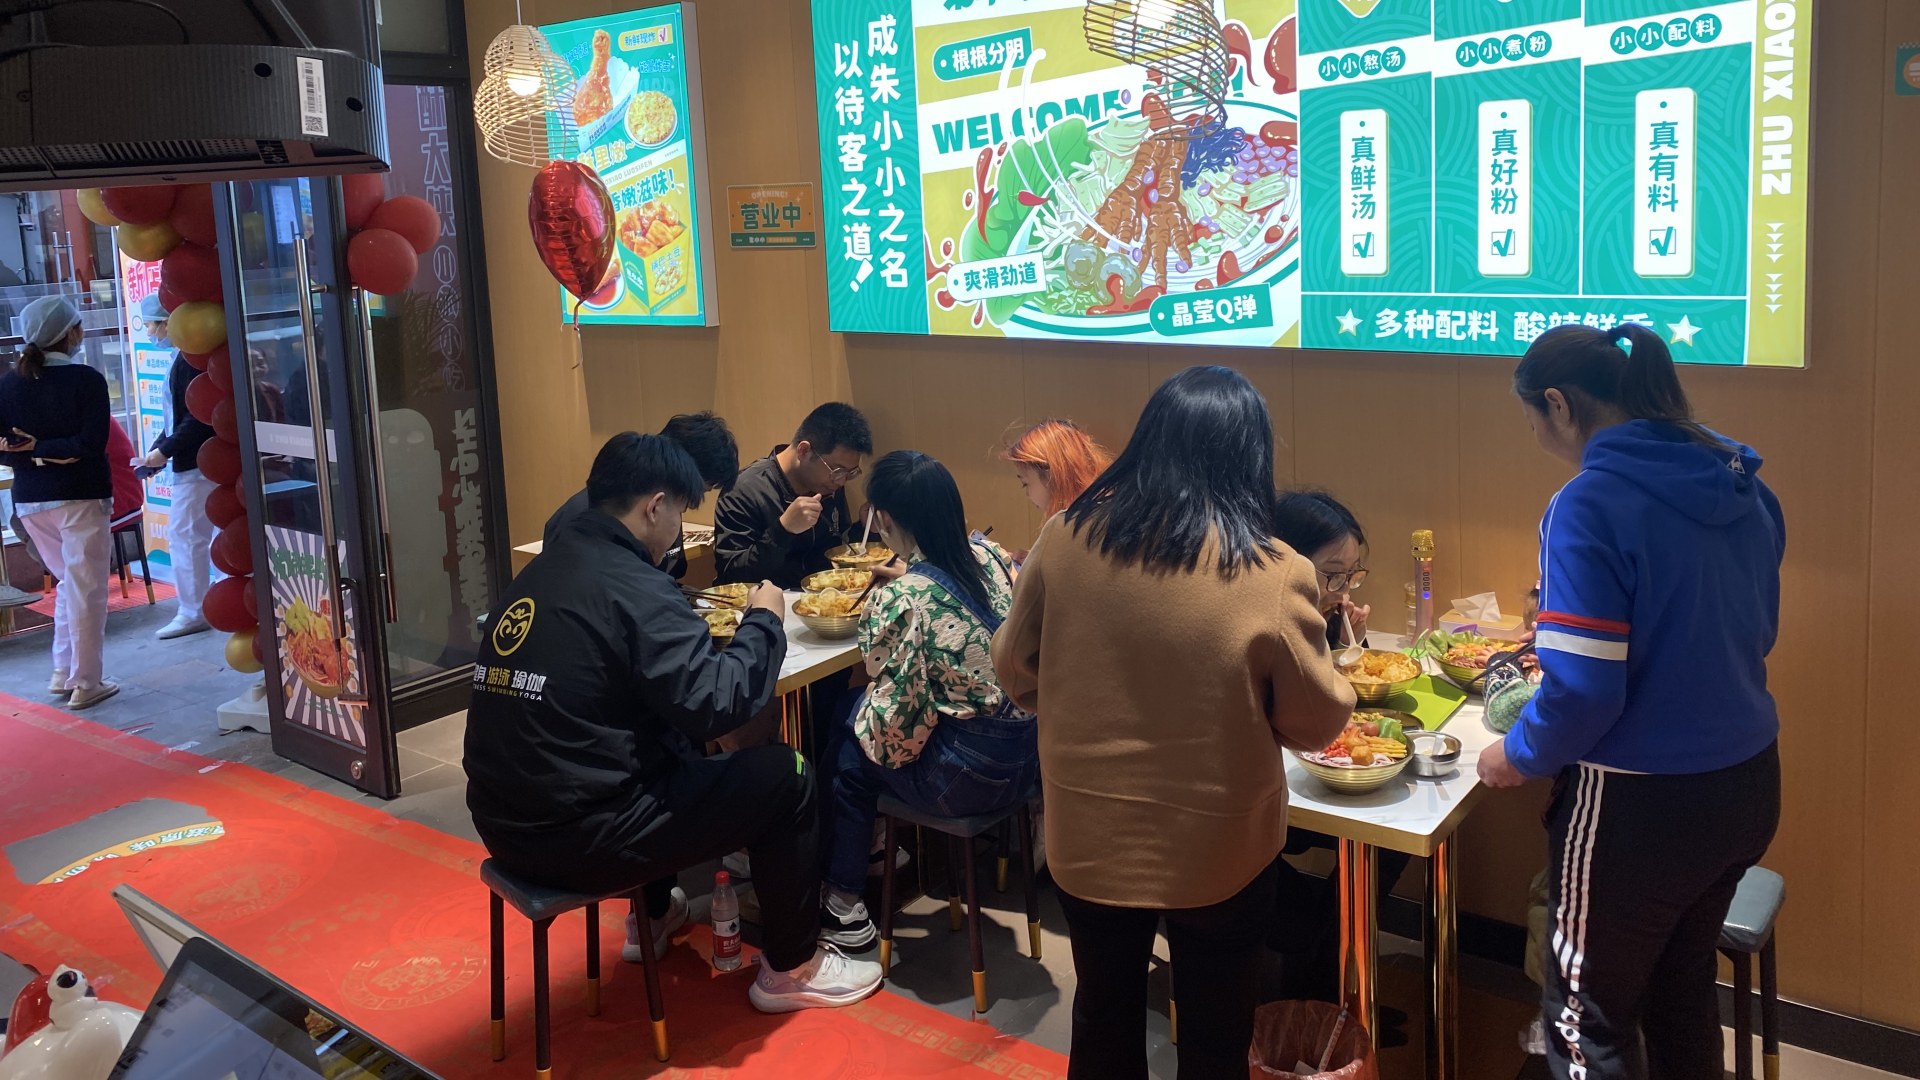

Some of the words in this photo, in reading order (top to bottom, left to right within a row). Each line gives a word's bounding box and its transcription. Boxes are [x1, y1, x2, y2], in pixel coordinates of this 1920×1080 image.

[1458, 36, 1548, 63] 小小煮粉
[1613, 18, 1716, 50] 小小配料
[952, 37, 1026, 72] 根根分明
[1320, 50, 1402, 78] 小小熬汤
[1762, 0, 1797, 103] XIAO
[867, 13, 909, 288] 成朱小小之名
[1648, 121, 1679, 213] 真有料
[1761, 115, 1793, 196] ZHU
[1351, 136, 1377, 220] 真鲜汤
[1491, 129, 1519, 215] 真好粉
[741, 202, 801, 230] 营业中
[963, 262, 1038, 292] 爽滑劲道
[1172, 294, 1258, 327] 晶莹Q弹
[1374, 308, 1499, 342] 多种配料
[519, 691, 542, 701] YOGA
